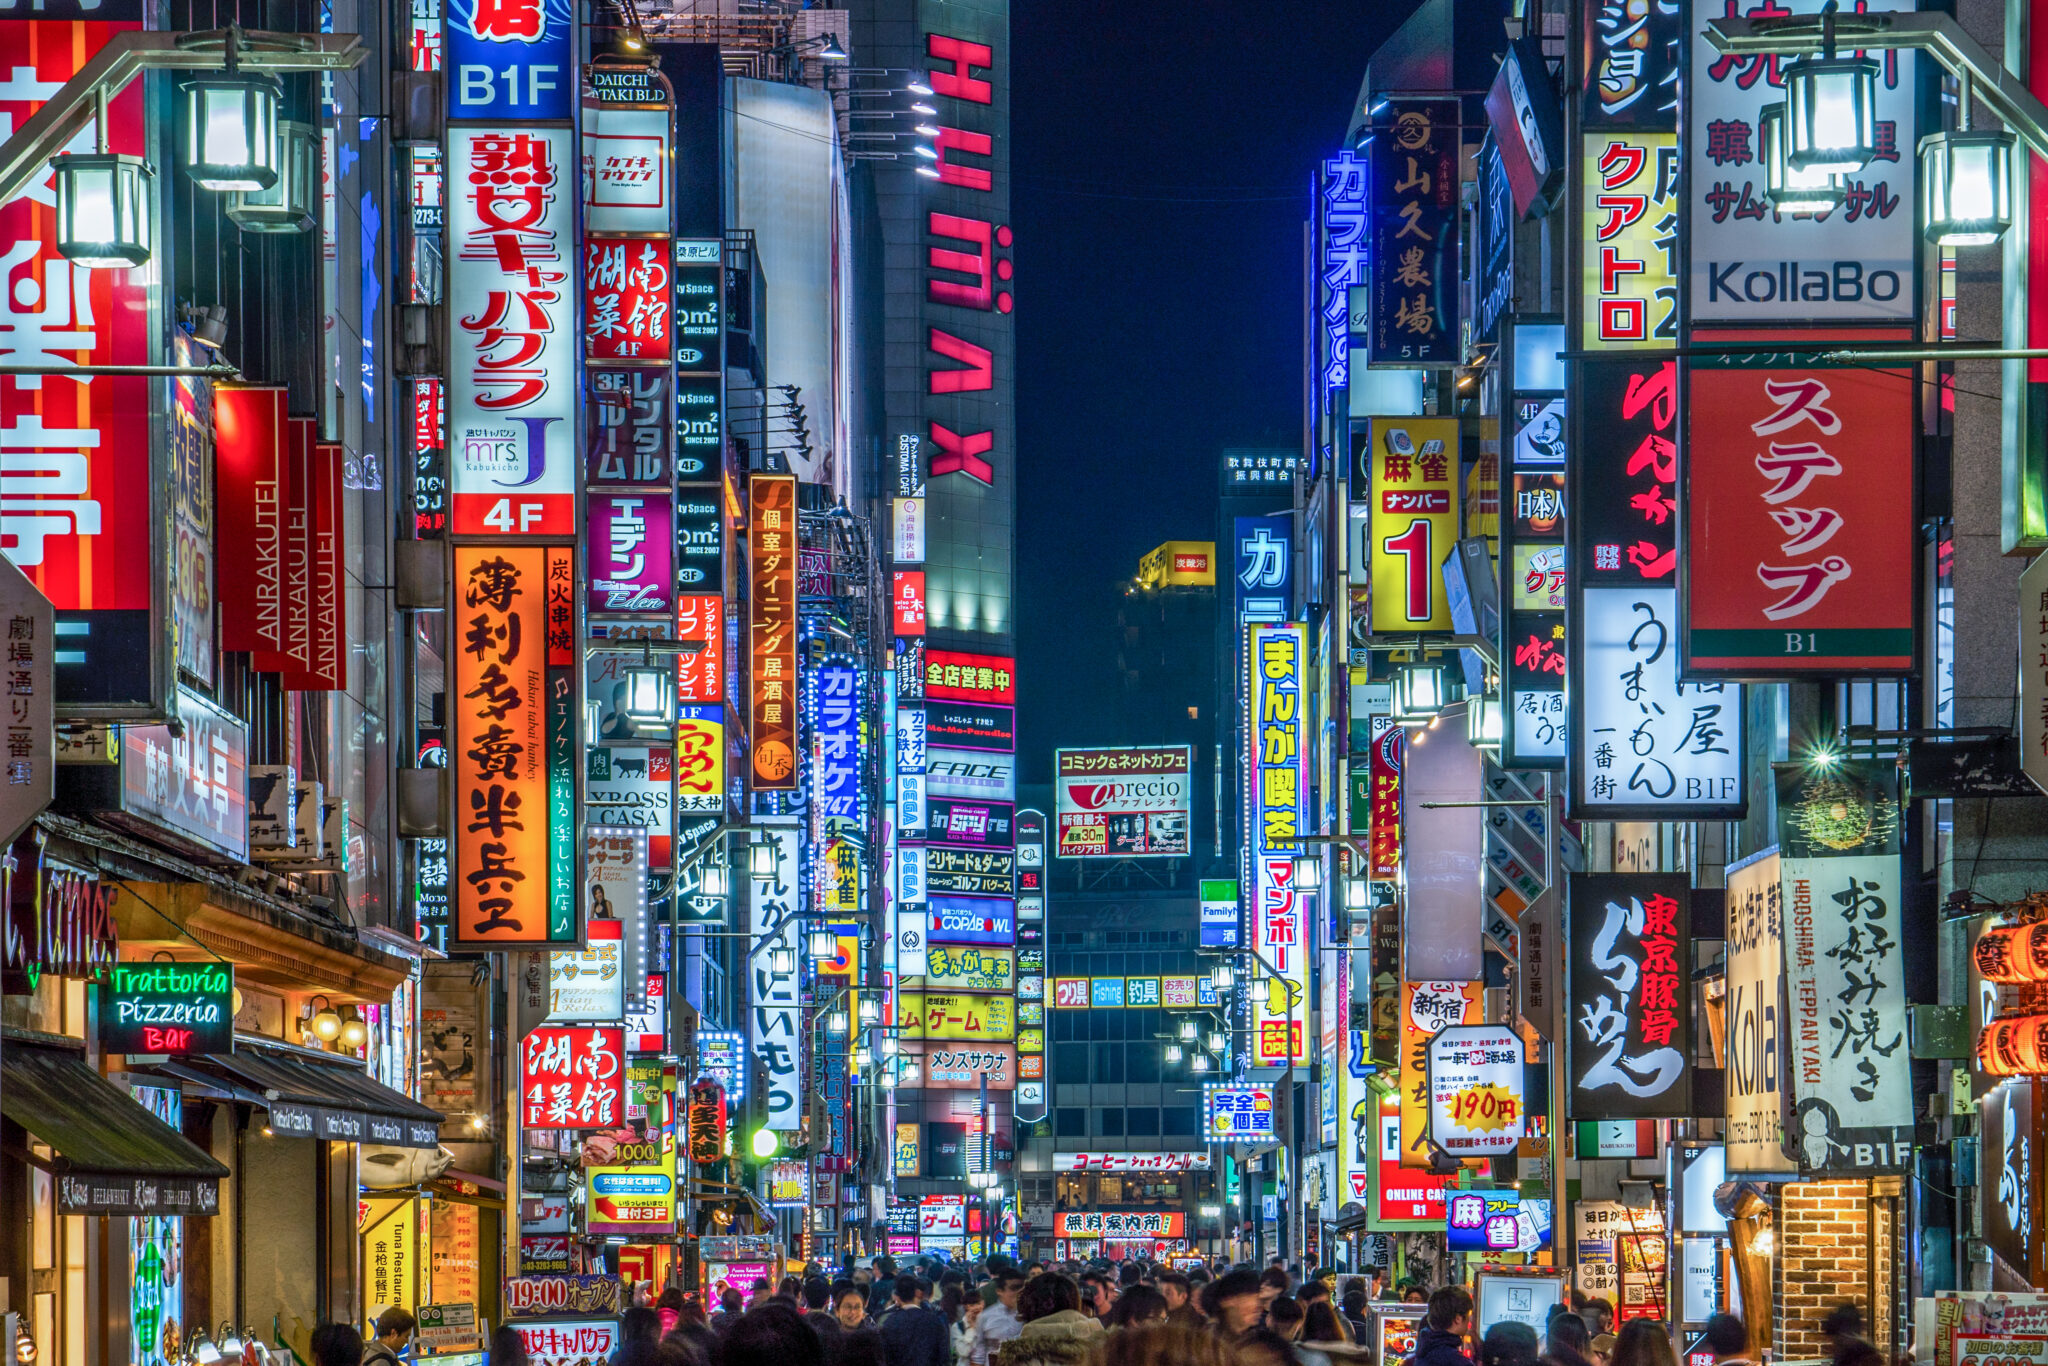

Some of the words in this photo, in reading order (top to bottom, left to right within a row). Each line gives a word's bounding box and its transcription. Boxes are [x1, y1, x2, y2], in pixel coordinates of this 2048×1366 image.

[459, 64, 559, 106] B1F
[595, 74, 649, 87] DAIICHI
[634, 89, 665, 102] BLD
[606, 155, 652, 168] カブキ
[599, 168, 656, 181] ラウンジ
[1393, 156, 1435, 336] 山久農場
[1597, 141, 1648, 341] クアトロ
[459, 134, 567, 410] 熟女キャバクラ
[1708, 261, 1902, 304] KollaBo
[687, 283, 713, 293] Space
[614, 341, 643, 357] 4F
[681, 350, 696, 360] 5F
[688, 393, 714, 403] Space
[1520, 403, 1539, 421] 4F
[633, 372, 660, 480] レンタル
[466, 463, 519, 471] Kabukicho
[682, 460, 697, 471] 4F
[1235, 470, 1290, 481] 振興組合
[1383, 453, 1449, 484] 麻雀
[899, 475, 911, 496] CAFE
[688, 503, 714, 513] Space
[1387, 493, 1448, 510] ナンバー
[1751, 377, 1853, 621] ステップ
[483, 498, 544, 532] 4F
[610, 499, 647, 581] エデン
[256, 480, 277, 641] ANRAKUTEI
[1384, 518, 1432, 621] 1
[287, 507, 306, 663] ANRAKUTEI
[683, 570, 698, 581] 3F
[317, 531, 335, 680] ANRAKUTEI
[550, 558, 573, 651] 炭火串焼
[605, 584, 666, 609] Eden
[761, 509, 783, 723] 個室ダイニング居酒屋
[1784, 633, 1818, 654] B1
[704, 663, 717, 696] ホステル
[926, 662, 1011, 693] 全店営業中
[8, 615, 34, 786] 劇場通り一番街
[1619, 601, 1678, 800] うまいもん
[822, 666, 854, 791] カラオケ
[1374, 717, 1392, 730] 3F
[911, 710, 925, 765] カラオケ
[927, 760, 1012, 780] FACE
[1061, 752, 1187, 771] コミック&ネットカフェ
[1590, 726, 1619, 801] 一番街
[1684, 777, 1737, 801] B1F
[902, 777, 918, 826] SEGA
[1120, 797, 1179, 808] アプレシオ
[600, 811, 661, 827] CASA
[1061, 813, 1106, 826] 新宿最大
[1116, 835, 1145, 846] ダーツ
[836, 843, 857, 905] 麻雀
[902, 851, 918, 900] SEGA
[952, 875, 981, 892] ゴルフ
[694, 896, 713, 908] B1
[904, 903, 916, 911] 1F
[1268, 862, 1294, 970] マンボー
[1793, 878, 1816, 967] HIROSHIMA
[1222, 928, 1236, 943] 酒
[928, 948, 1011, 979] まんが喫茶
[1639, 892, 1680, 1046] 東京豚骨
[113, 965, 228, 994] Trattoria
[1164, 979, 1195, 991] お売り
[1824, 876, 1896, 1099] お好み焼き
[1057, 980, 1088, 1006] つり具
[1093, 981, 1122, 1004] Fishing
[1128, 980, 1159, 1004] 釣具
[1164, 992, 1195, 1005] 下さい
[117, 996, 219, 1023] Pizzeria
[1414, 991, 1463, 1020] 新宿
[927, 1008, 982, 1033] ゲーム
[144, 1027, 193, 1050] Bar
[930, 1049, 1008, 1071] メンズサウナ
[1215, 1094, 1255, 1112] 完全
[1454, 1091, 1517, 1120] 190円
[1232, 1112, 1271, 1130] 個室
[1683, 1142, 1698, 1151] 5F
[1846, 1135, 1903, 1160] B1F
[1072, 1153, 1127, 1170] コーヒー
[1130, 1155, 1162, 1167] ショップ
[1165, 1152, 1193, 1170] クール
[1385, 1188, 1425, 1202] ONLINE
[1486, 1200, 1519, 1213] フリー
[923, 1213, 963, 1229] ゲーム
[1065, 1213, 1162, 1232] 無料案内所
[1412, 1204, 1427, 1217] B1
[1453, 1194, 1519, 1248] 麻雀
[393, 1222, 405, 1249] Tuna
[375, 1240, 388, 1304] 金枪鱼餐厅
[510, 1279, 567, 1309] 19:00
[568, 1279, 617, 1312] オープン
[1685, 1332, 1700, 1342] 1F
[1966, 1339, 2044, 1356] 初回のお客様
